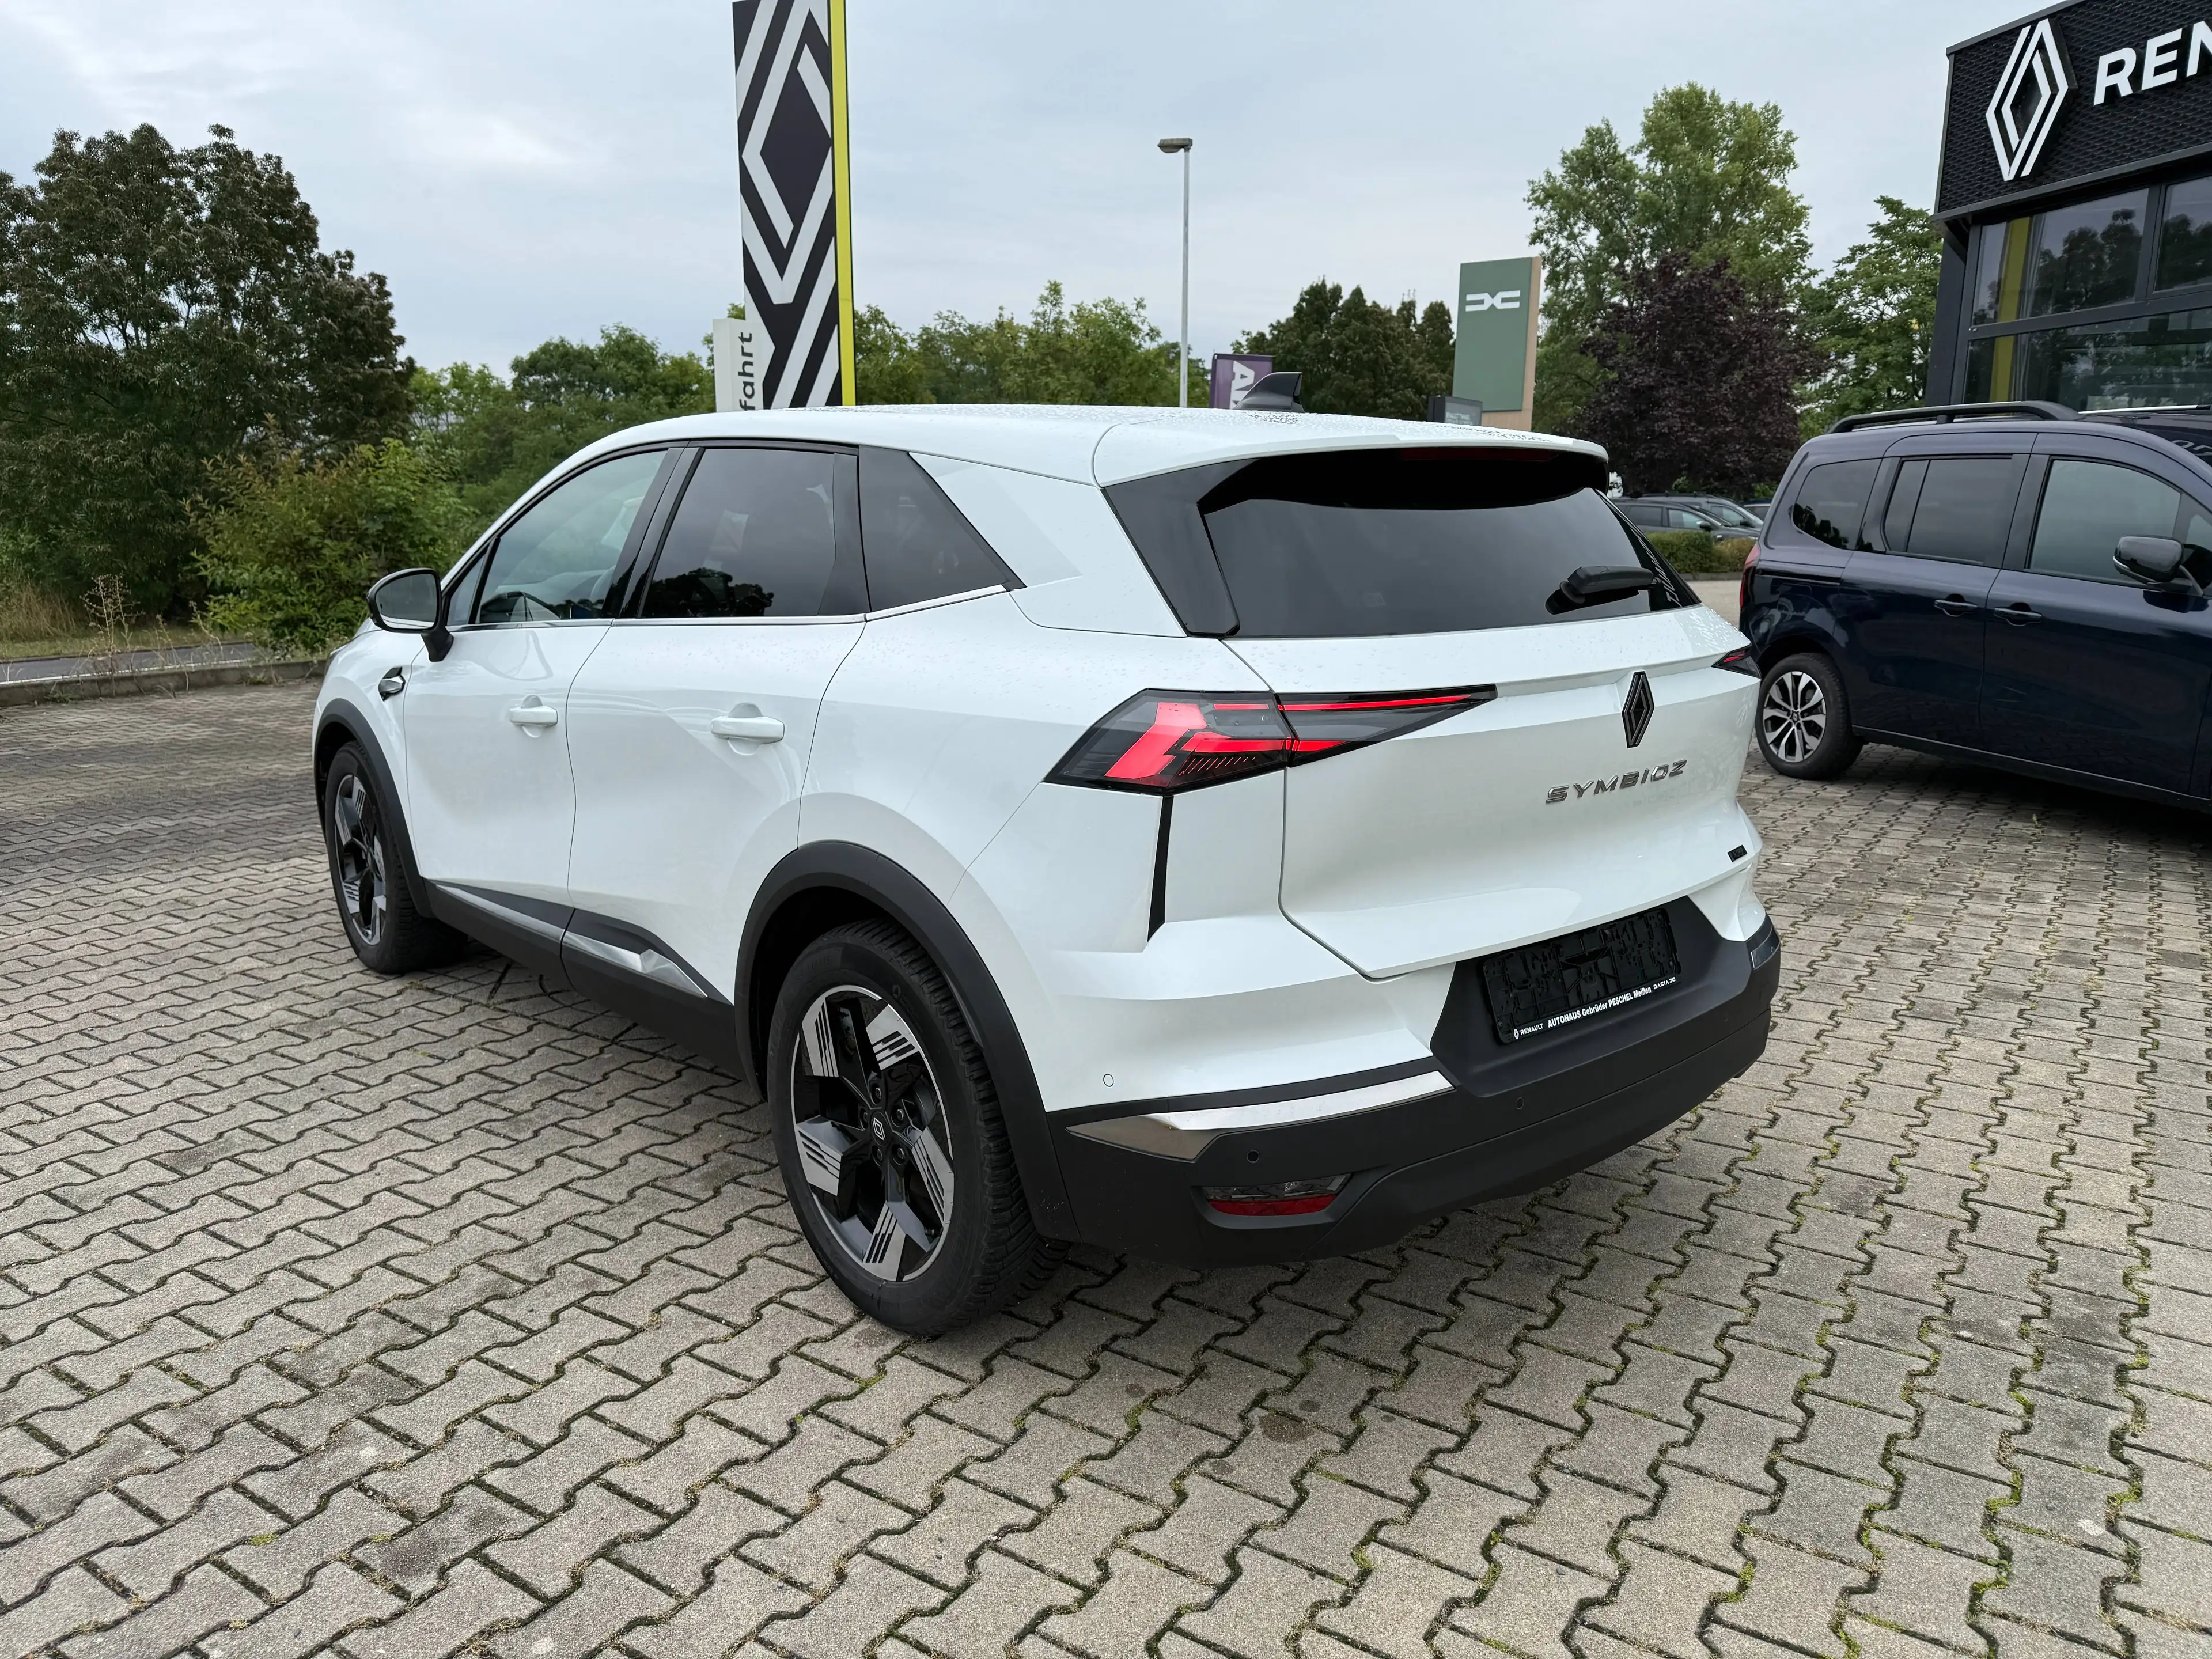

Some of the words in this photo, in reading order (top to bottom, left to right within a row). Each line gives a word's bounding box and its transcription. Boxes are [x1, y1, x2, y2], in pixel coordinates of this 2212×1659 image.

[1546, 759, 1687, 804] SYMBIOZ
[1520, 1023, 1543, 1035] RENAULT
[1548, 1010, 1581, 1028] AUTOHAUS
[1581, 1003, 1608, 1017] Gebrüder
[1608, 992, 1633, 1007] PESCHEL
[1633, 987, 1652, 999] Meißen
[1653, 980, 1669, 990] DACIA
